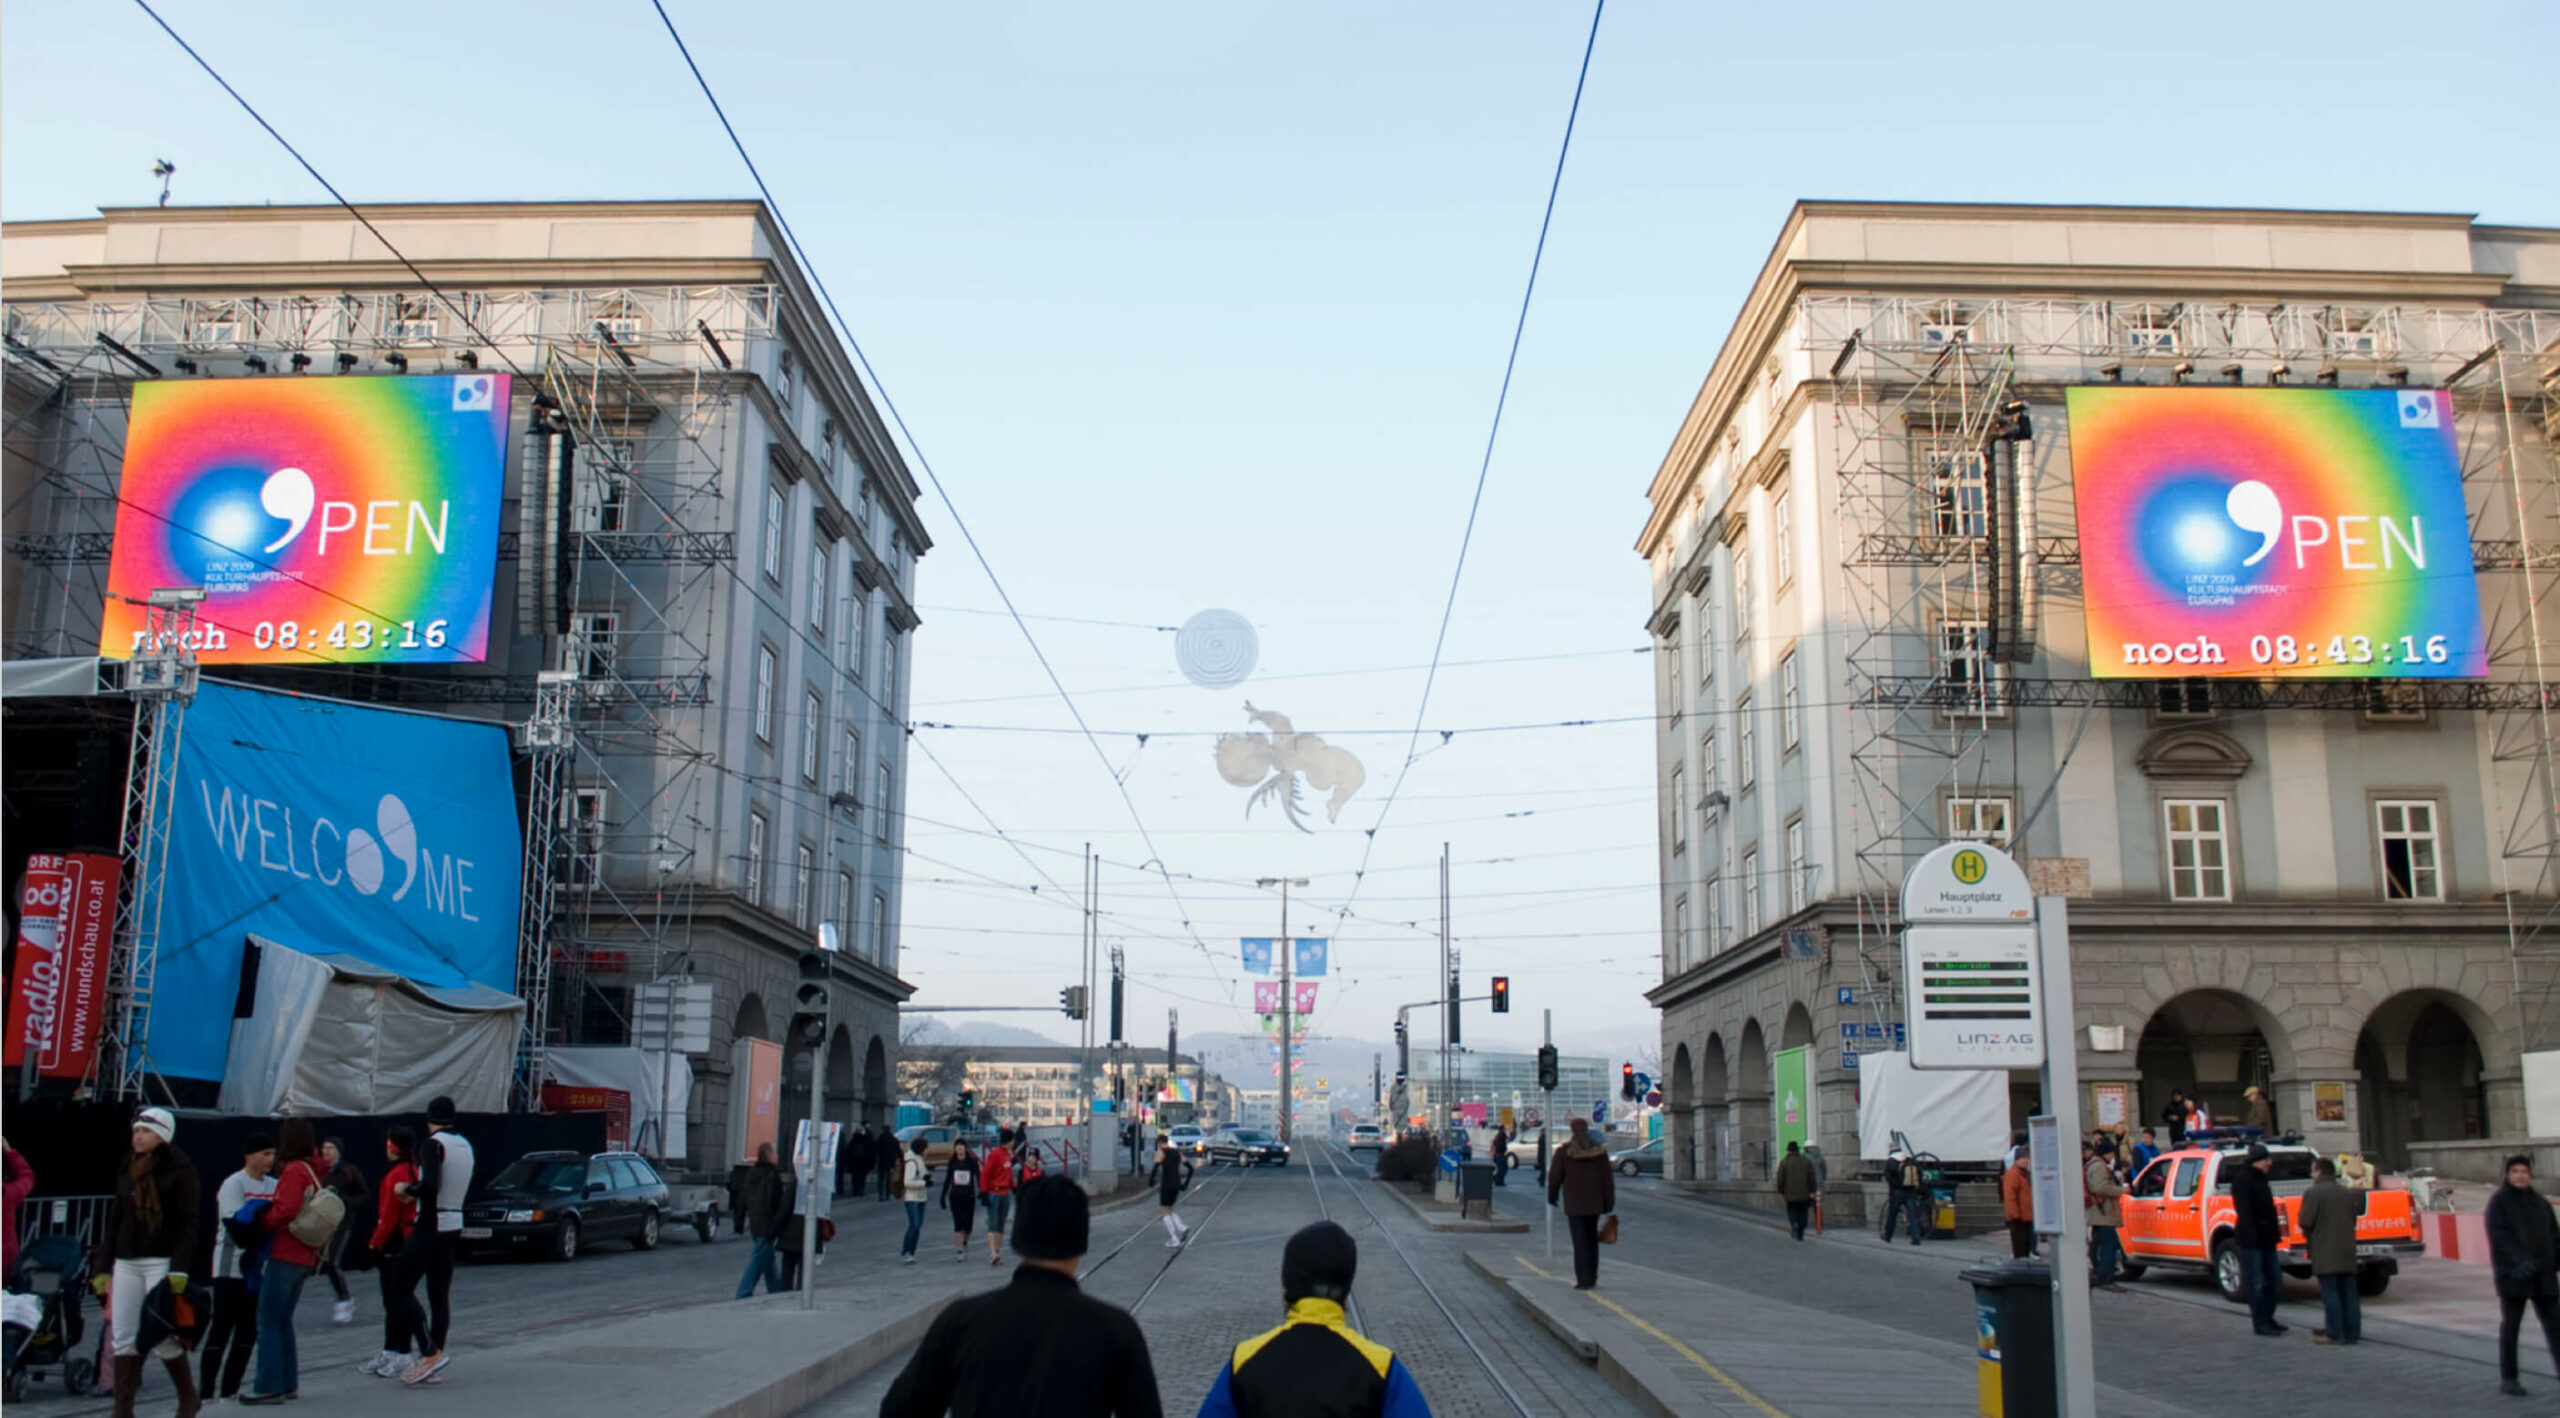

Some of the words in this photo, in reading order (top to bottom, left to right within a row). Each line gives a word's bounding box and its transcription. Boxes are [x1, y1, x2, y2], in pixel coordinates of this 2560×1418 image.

[2211, 575, 2236, 584] 2009
[132, 622, 227, 651] noch
[253, 619, 448, 650] 08:43:16
[2122, 636, 2226, 664] noch
[2250, 634, 2448, 664] 08:43:16
[29, 855, 64, 868] ORF
[1961, 855, 1978, 878] H
[1940, 891, 2002, 903] Hauptplatz
[70, 880, 105, 1053] www.rundschau.co.at
[22, 961, 53, 1047] radio
[2006, 1034, 2034, 1044] AG
